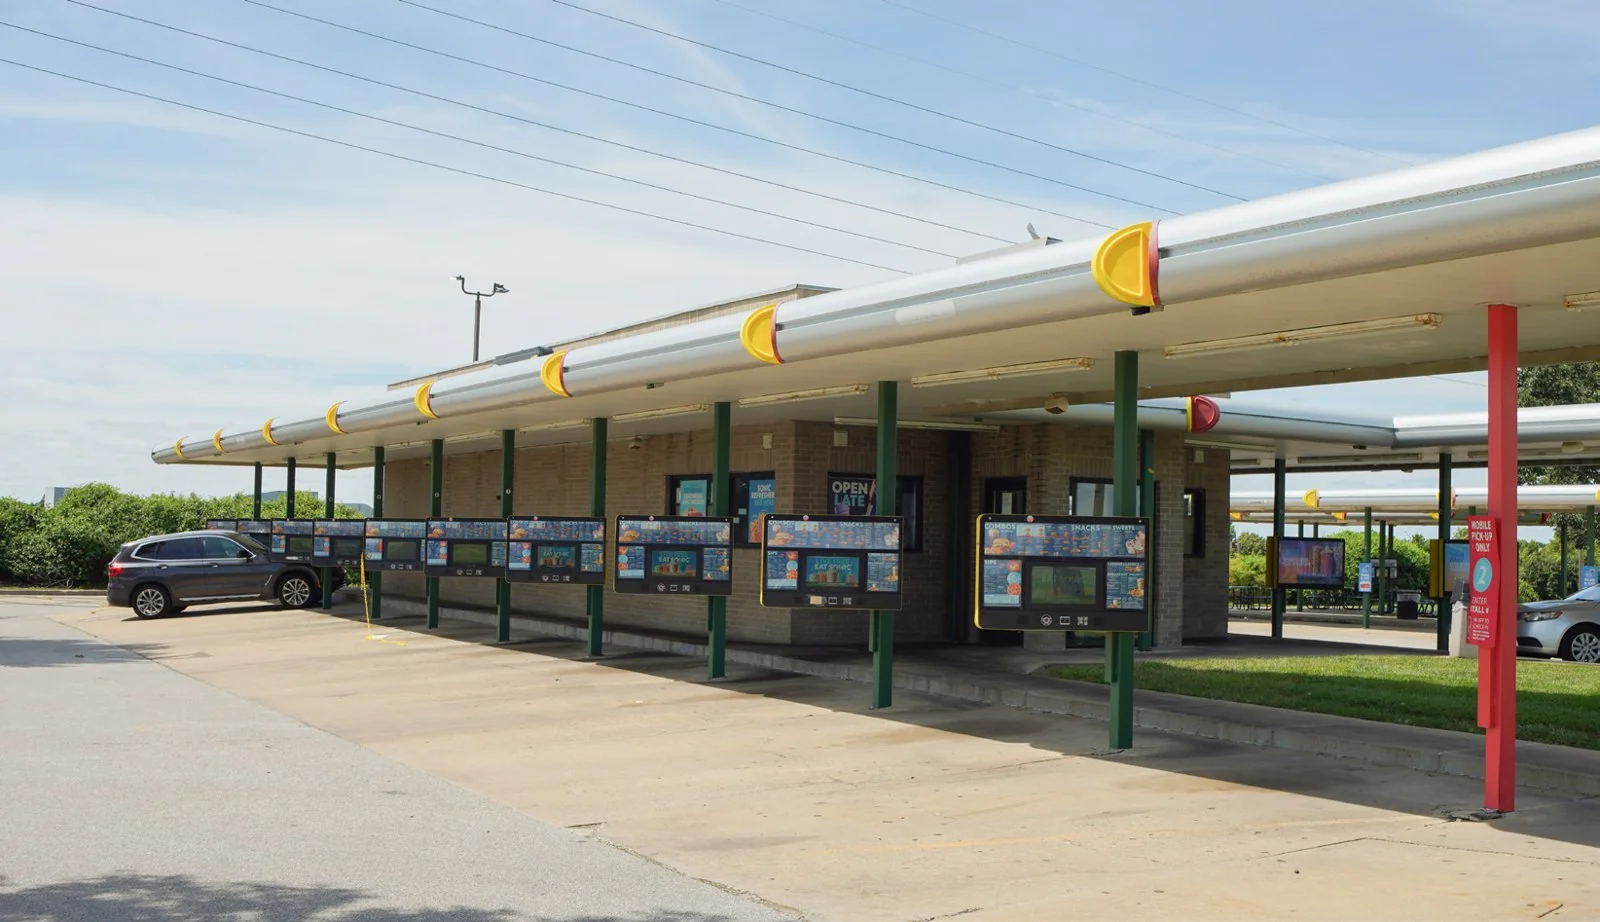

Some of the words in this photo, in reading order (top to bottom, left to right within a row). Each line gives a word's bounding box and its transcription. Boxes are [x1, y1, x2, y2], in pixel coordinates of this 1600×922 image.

[832, 481, 868, 494] OPEN
[834, 494, 865, 507] LATE
[1471, 520, 1491, 530] MOBILE
[1471, 531, 1492, 541] PICK-UP
[1475, 542, 1490, 552] ONLY
[1478, 565, 1486, 584] 2
[1471, 596, 1488, 604] ENTER
